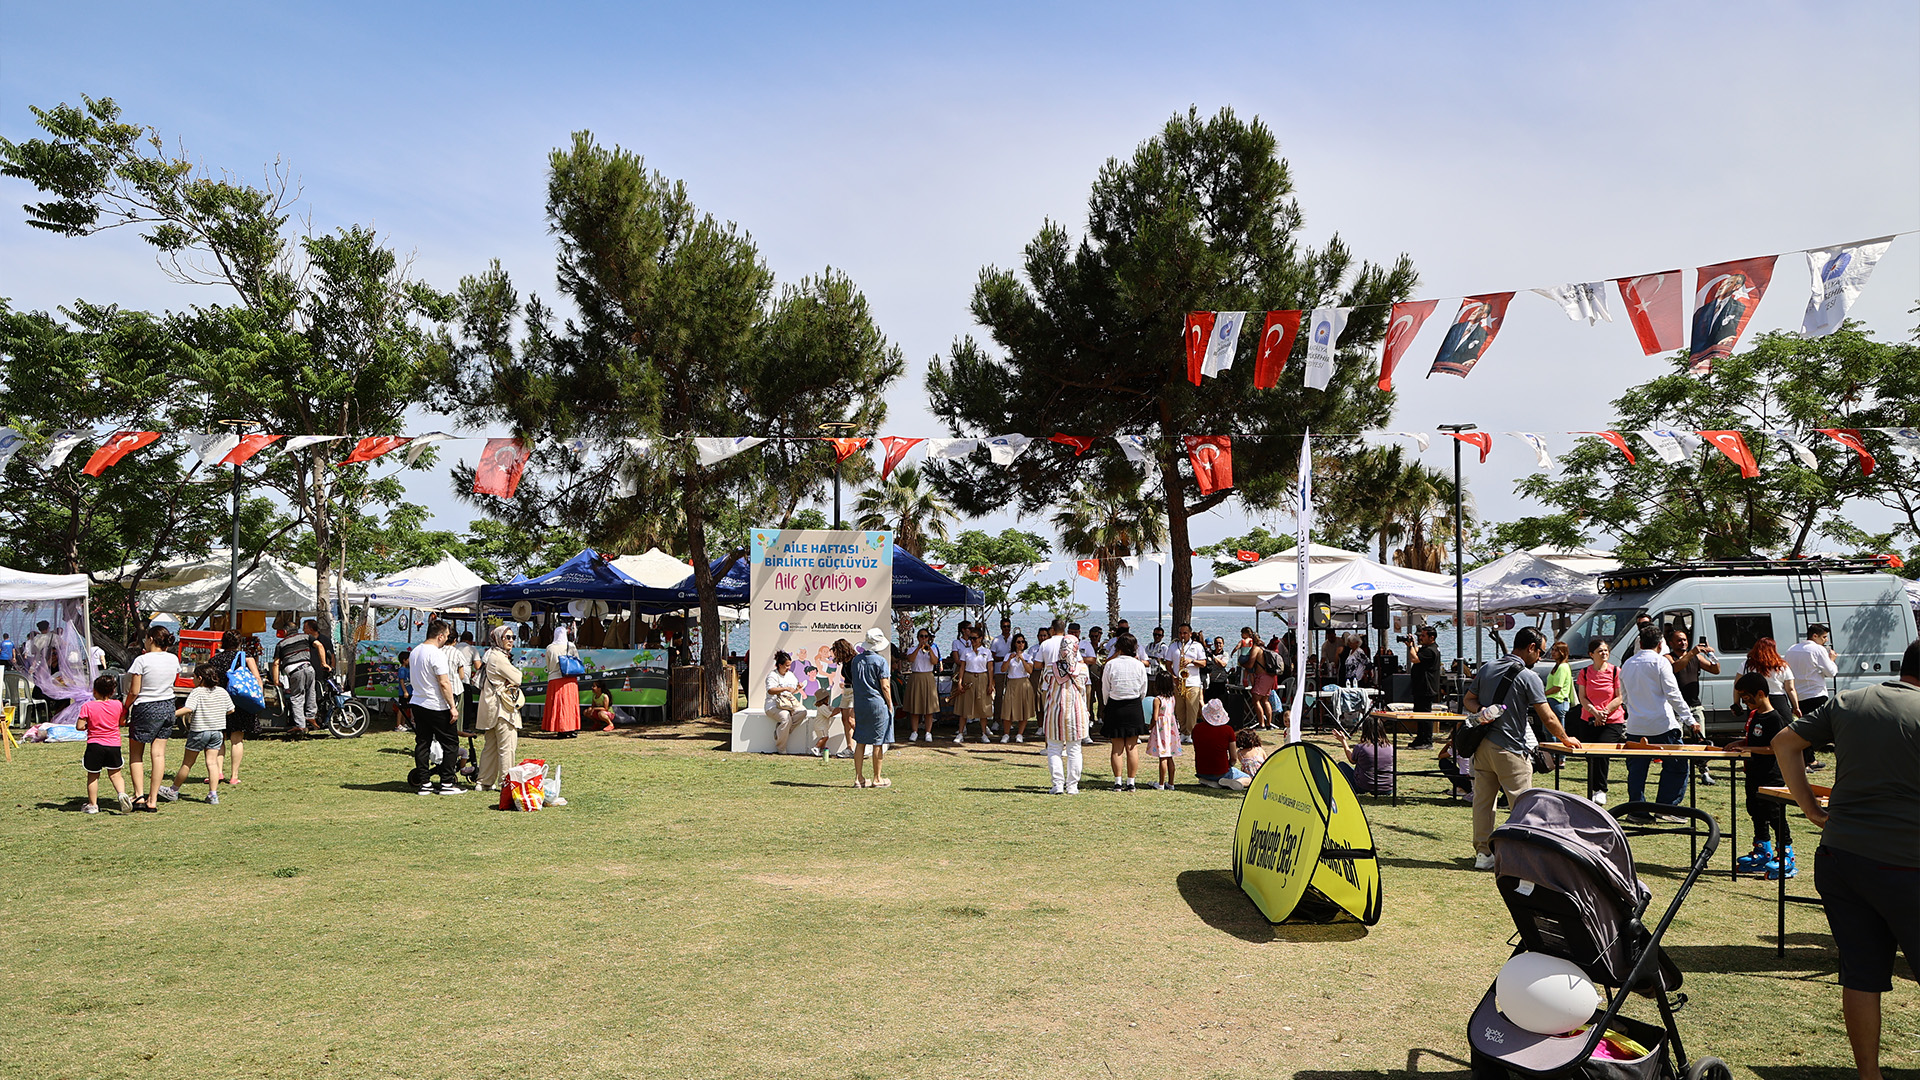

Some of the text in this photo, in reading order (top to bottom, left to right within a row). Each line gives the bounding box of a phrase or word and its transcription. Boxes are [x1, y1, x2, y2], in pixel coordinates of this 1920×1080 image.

[783, 541, 859, 554] AİLE HAFTASI
[764, 554, 878, 570] BİRLİKTE GÜÇLÜYÜZ
[775, 572, 852, 596] Aile Şenliği
[764, 600, 878, 615] Zumba Etkinliği
[840, 622, 862, 630] BÖCEK
[1245, 820, 1281, 871] Harekete
[1276, 823, 1298, 889] Geç
[1291, 826, 1306, 877] !
